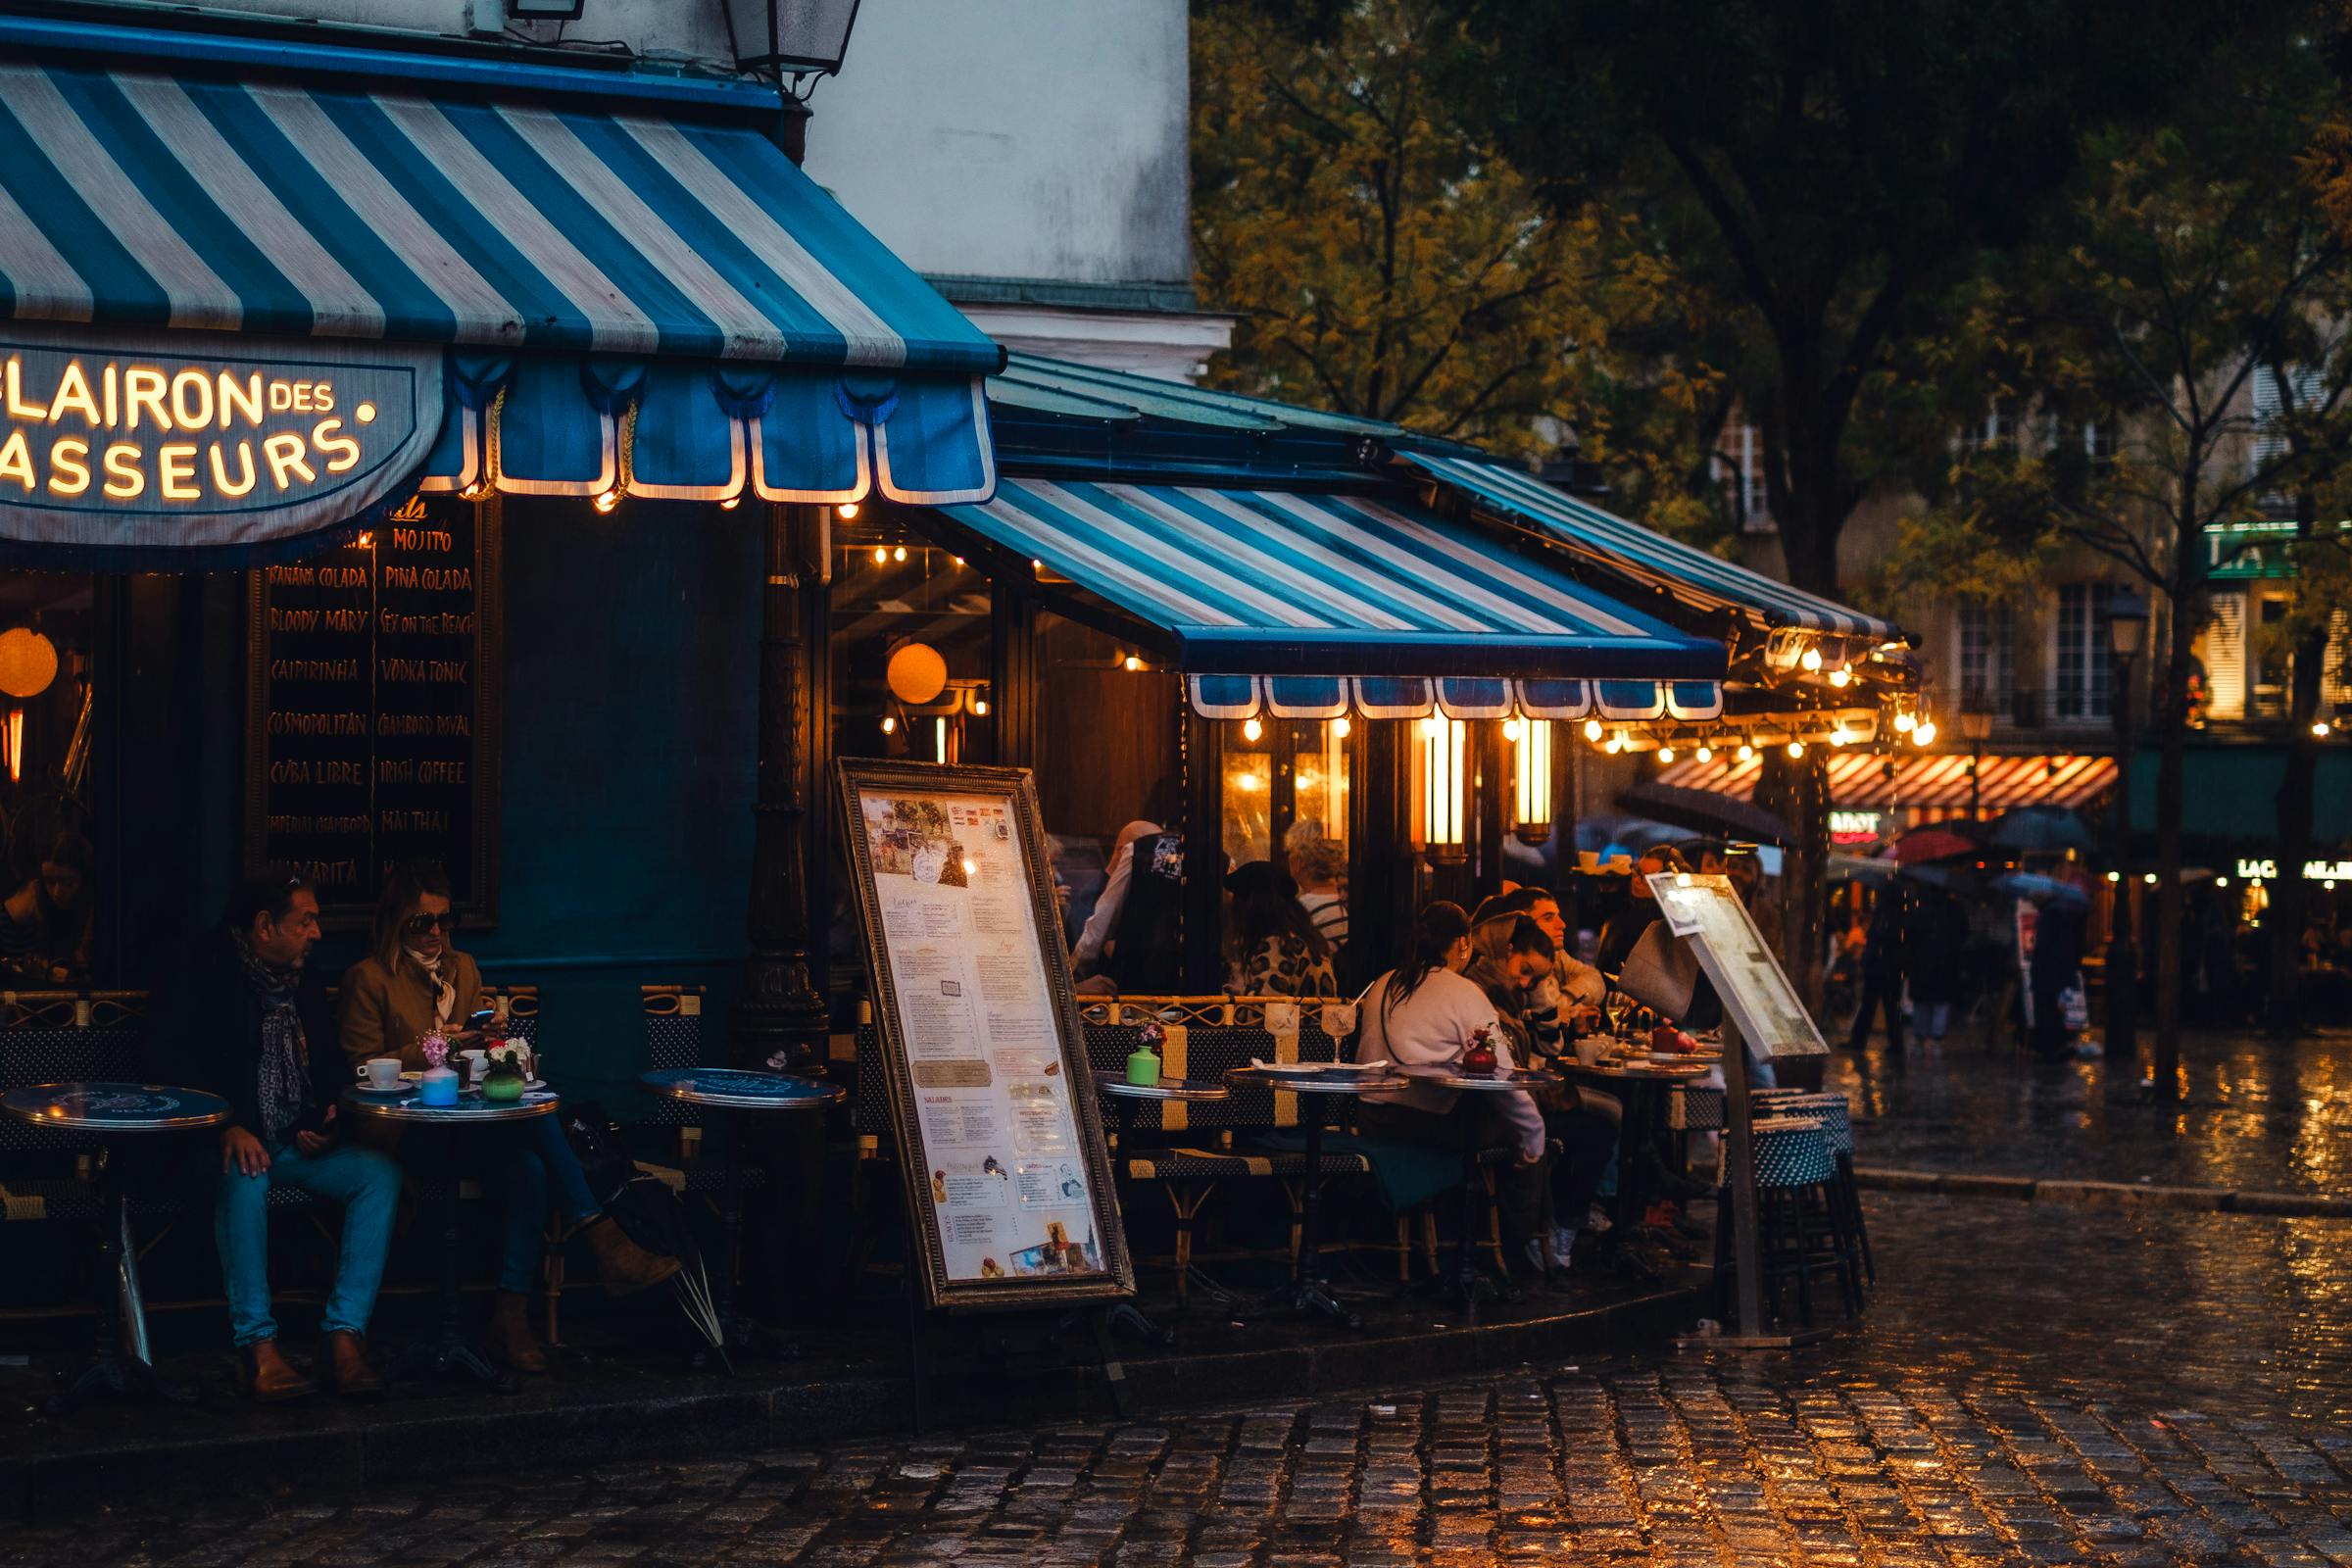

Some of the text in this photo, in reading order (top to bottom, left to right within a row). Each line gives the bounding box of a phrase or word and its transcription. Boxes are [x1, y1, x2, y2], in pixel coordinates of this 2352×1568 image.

[0, 360, 335, 430] LAIRON DES
[393, 528, 452, 552] MOJITO
[318, 566, 368, 588] COLADA
[421, 567, 472, 591] COLADA
[270, 608, 368, 632] BLOODY MARY
[402, 616, 416, 632] ON
[419, 615, 439, 634] THE
[442, 612, 474, 635] BEACH
[381, 659, 467, 683] VODKA TONIC
[267, 711, 367, 735] COSMOPOLITAN
[437, 714, 470, 736] ROYAL
[270, 760, 362, 784] CUBA LIBRE
[380, 760, 466, 784] IRISH COFFEE
[382, 810, 408, 832] MAI
